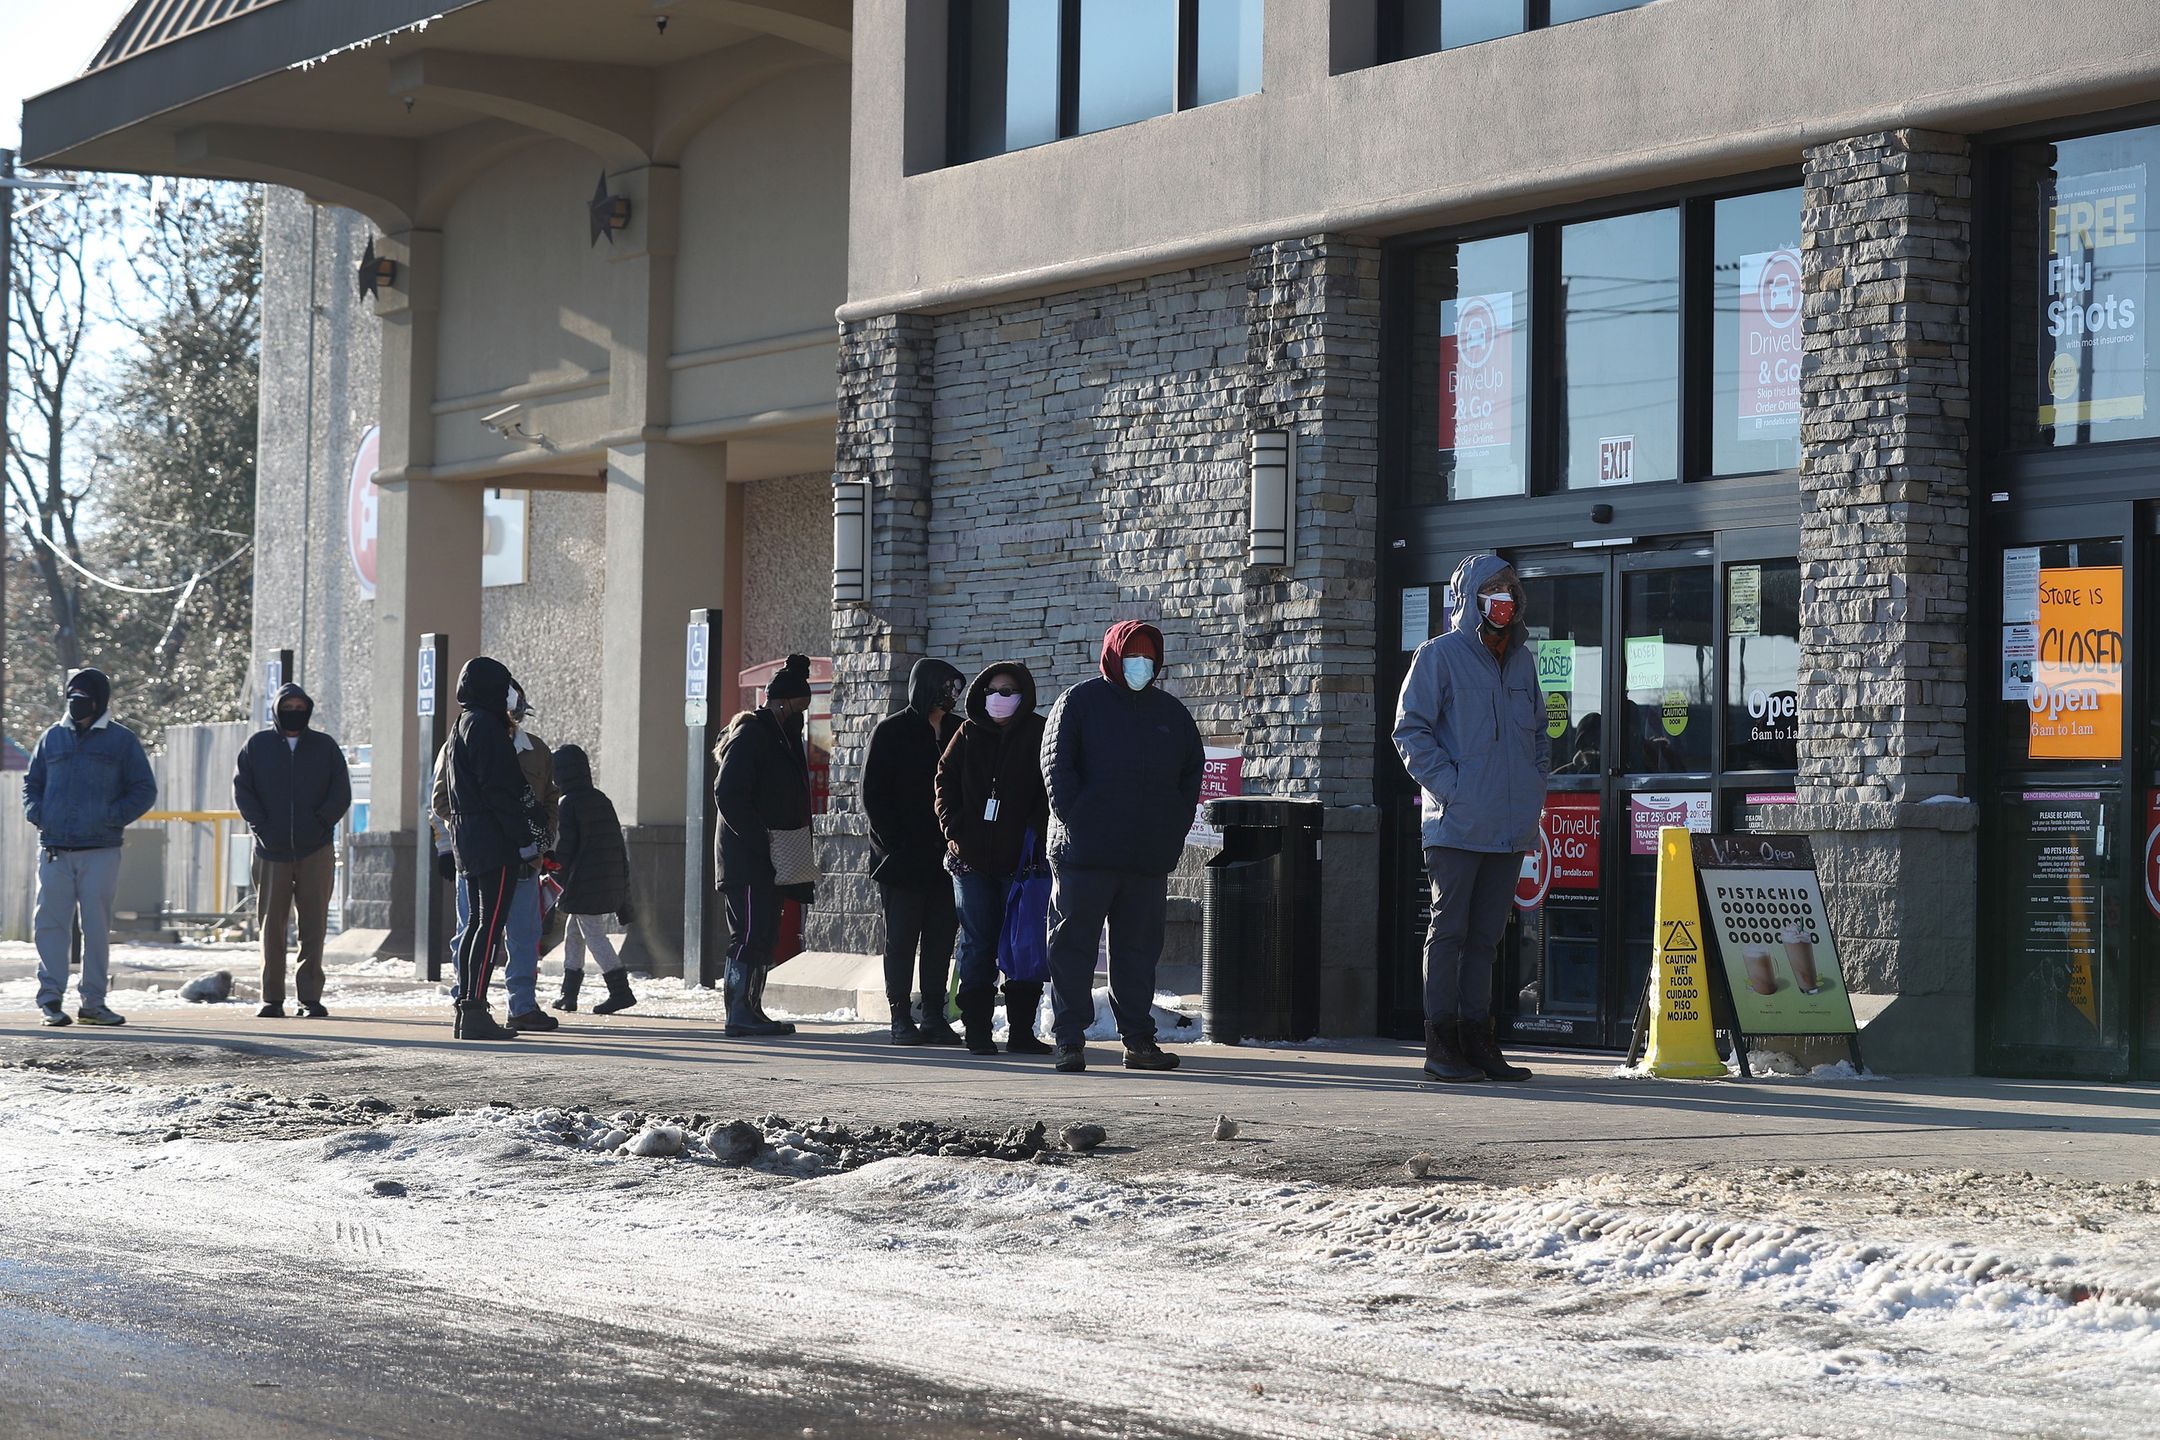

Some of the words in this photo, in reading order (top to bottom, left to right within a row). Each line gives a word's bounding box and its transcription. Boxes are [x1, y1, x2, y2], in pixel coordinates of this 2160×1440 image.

[2049, 194, 2136, 255] FREE
[2048, 256, 2091, 295] Flu
[2048, 294, 2135, 337] Shots
[1750, 328, 1801, 355] DriveU
[2066, 339, 2080, 349] with
[2081, 337, 2099, 347] most
[1759, 361, 1771, 385] &
[1775, 358, 1800, 383] Go
[1449, 367, 1503, 393] DriveUp
[1757, 388, 1773, 399] Skip
[1457, 398, 1466, 419] &
[1469, 396, 1492, 418] Go
[1755, 403, 1777, 413] Order
[1602, 441, 1631, 480] EXIT
[2040, 581, 2081, 605] STORE
[2089, 588, 2103, 605] IS
[1629, 643, 1657, 659] CLOSED
[2041, 627, 2122, 674] CLOSED
[1539, 655, 1572, 676] CLOSED
[2027, 681, 2099, 720] Open
[1547, 711, 1567, 720] AUTION
[1663, 708, 1687, 717] CAUTION
[1751, 726, 1773, 740] 6am
[1775, 728, 1784, 740] to
[1786, 726, 1798, 740] 1a
[2031, 721, 2055, 736] 6am
[2057, 724, 2068, 735] to
[2071, 721, 2094, 735] 1am
[1204, 761, 1227, 774] OFF
[1201, 780, 1209, 790] &
[1210, 781, 1228, 792] FILL
[1696, 801, 1707, 809] GET
[1635, 812, 1650, 822] GET
[1650, 811, 1665, 822] 25%
[1666, 811, 1681, 822] OFF
[2039, 811, 2056, 819] PLEASE
[2056, 811, 2063, 819] BE
[2063, 811, 2082, 819] CAREFUL
[1552, 814, 1600, 840] DriveUp
[1635, 829, 1659, 839] TRANSF
[1552, 837, 1562, 858] &
[1564, 837, 1585, 858] Go
[1760, 841, 1795, 861] Open
[2062, 846, 2079, 854] PLEASE
[1562, 868, 1593, 877] randalls.com
[1717, 887, 1808, 900] PISTACHIO
[1665, 954, 1697, 964] CAUTION
[1674, 965, 1688, 975] WET
[1670, 977, 1693, 986] FLOOR
[1666, 989, 1698, 999] CUIDADO
[1674, 1000, 1691, 1010] PISO
[1667, 1011, 1698, 1021] MOJADO
